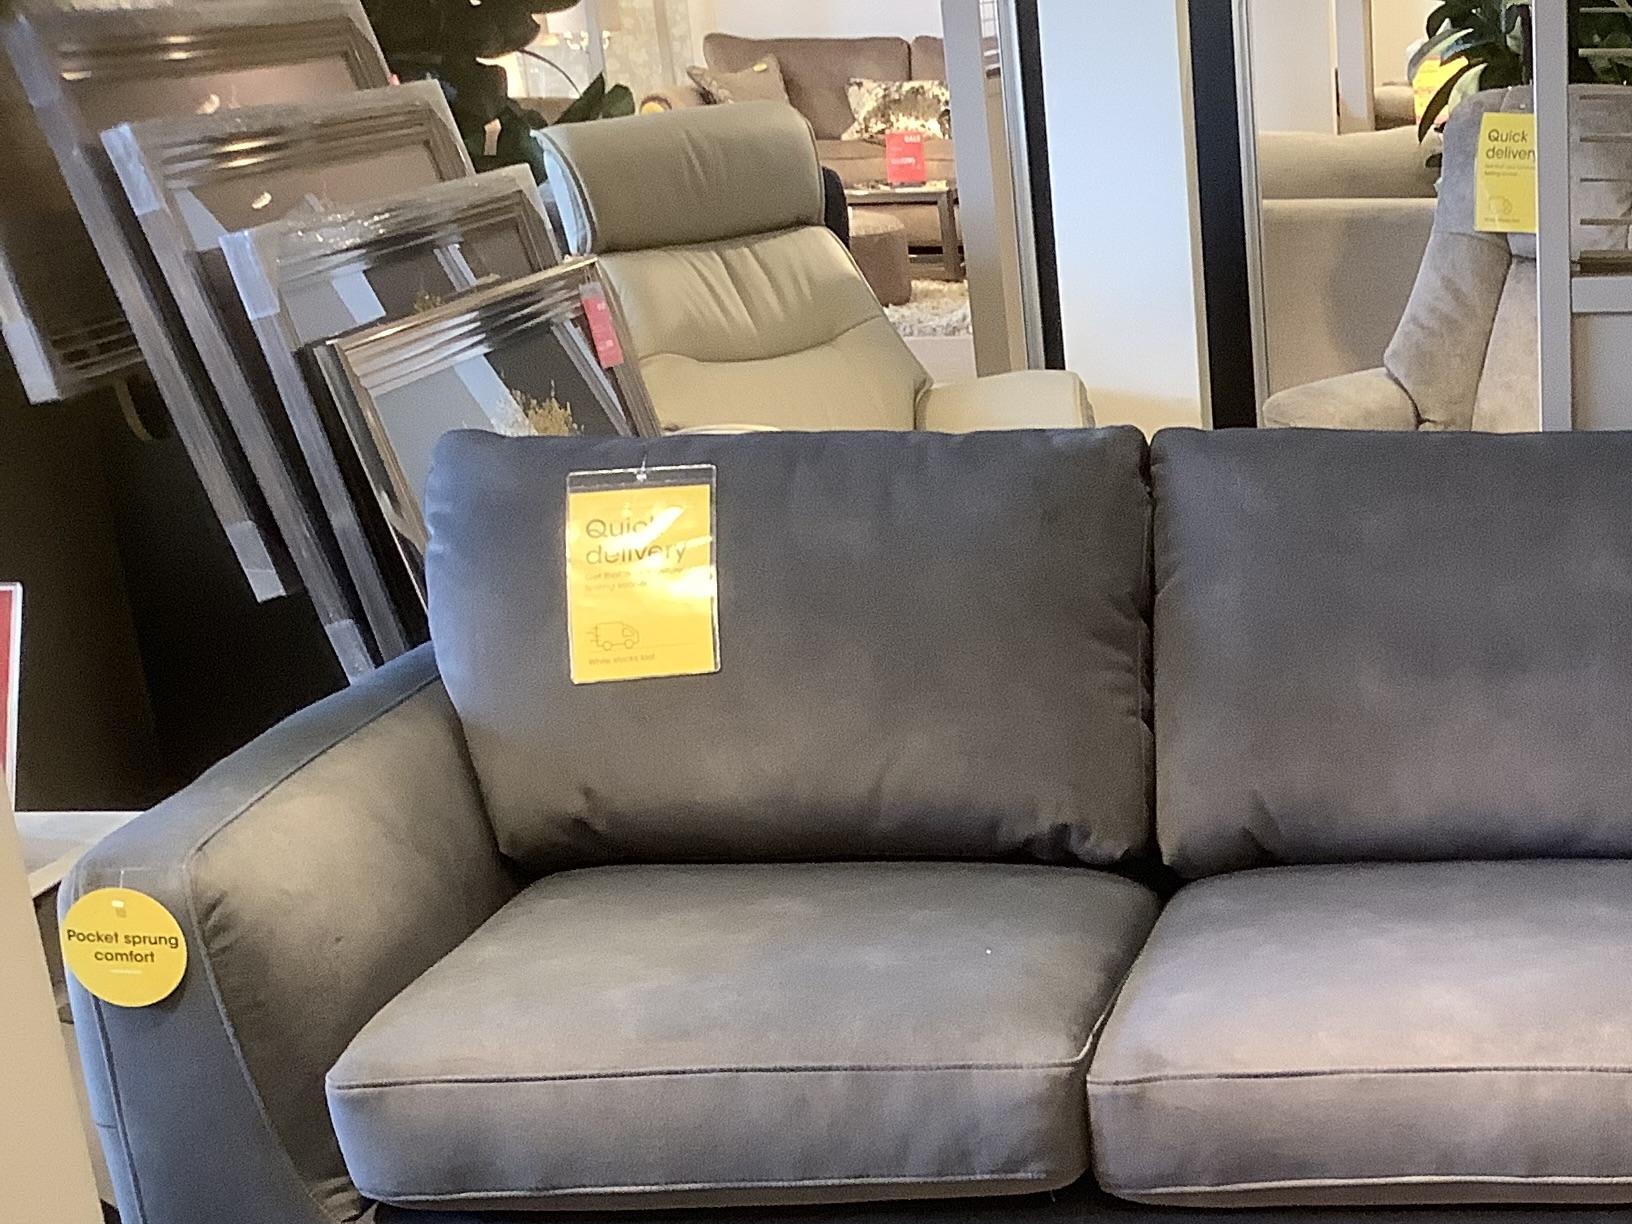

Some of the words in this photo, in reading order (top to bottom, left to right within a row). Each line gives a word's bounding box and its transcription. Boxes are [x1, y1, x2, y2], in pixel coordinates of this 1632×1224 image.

[1487, 128, 1529, 144] Quick
[585, 544, 687, 565] delivery
[66, 928, 119, 944] Pocket
[124, 934, 179, 949] sprung
[94, 950, 155, 963] comfort
